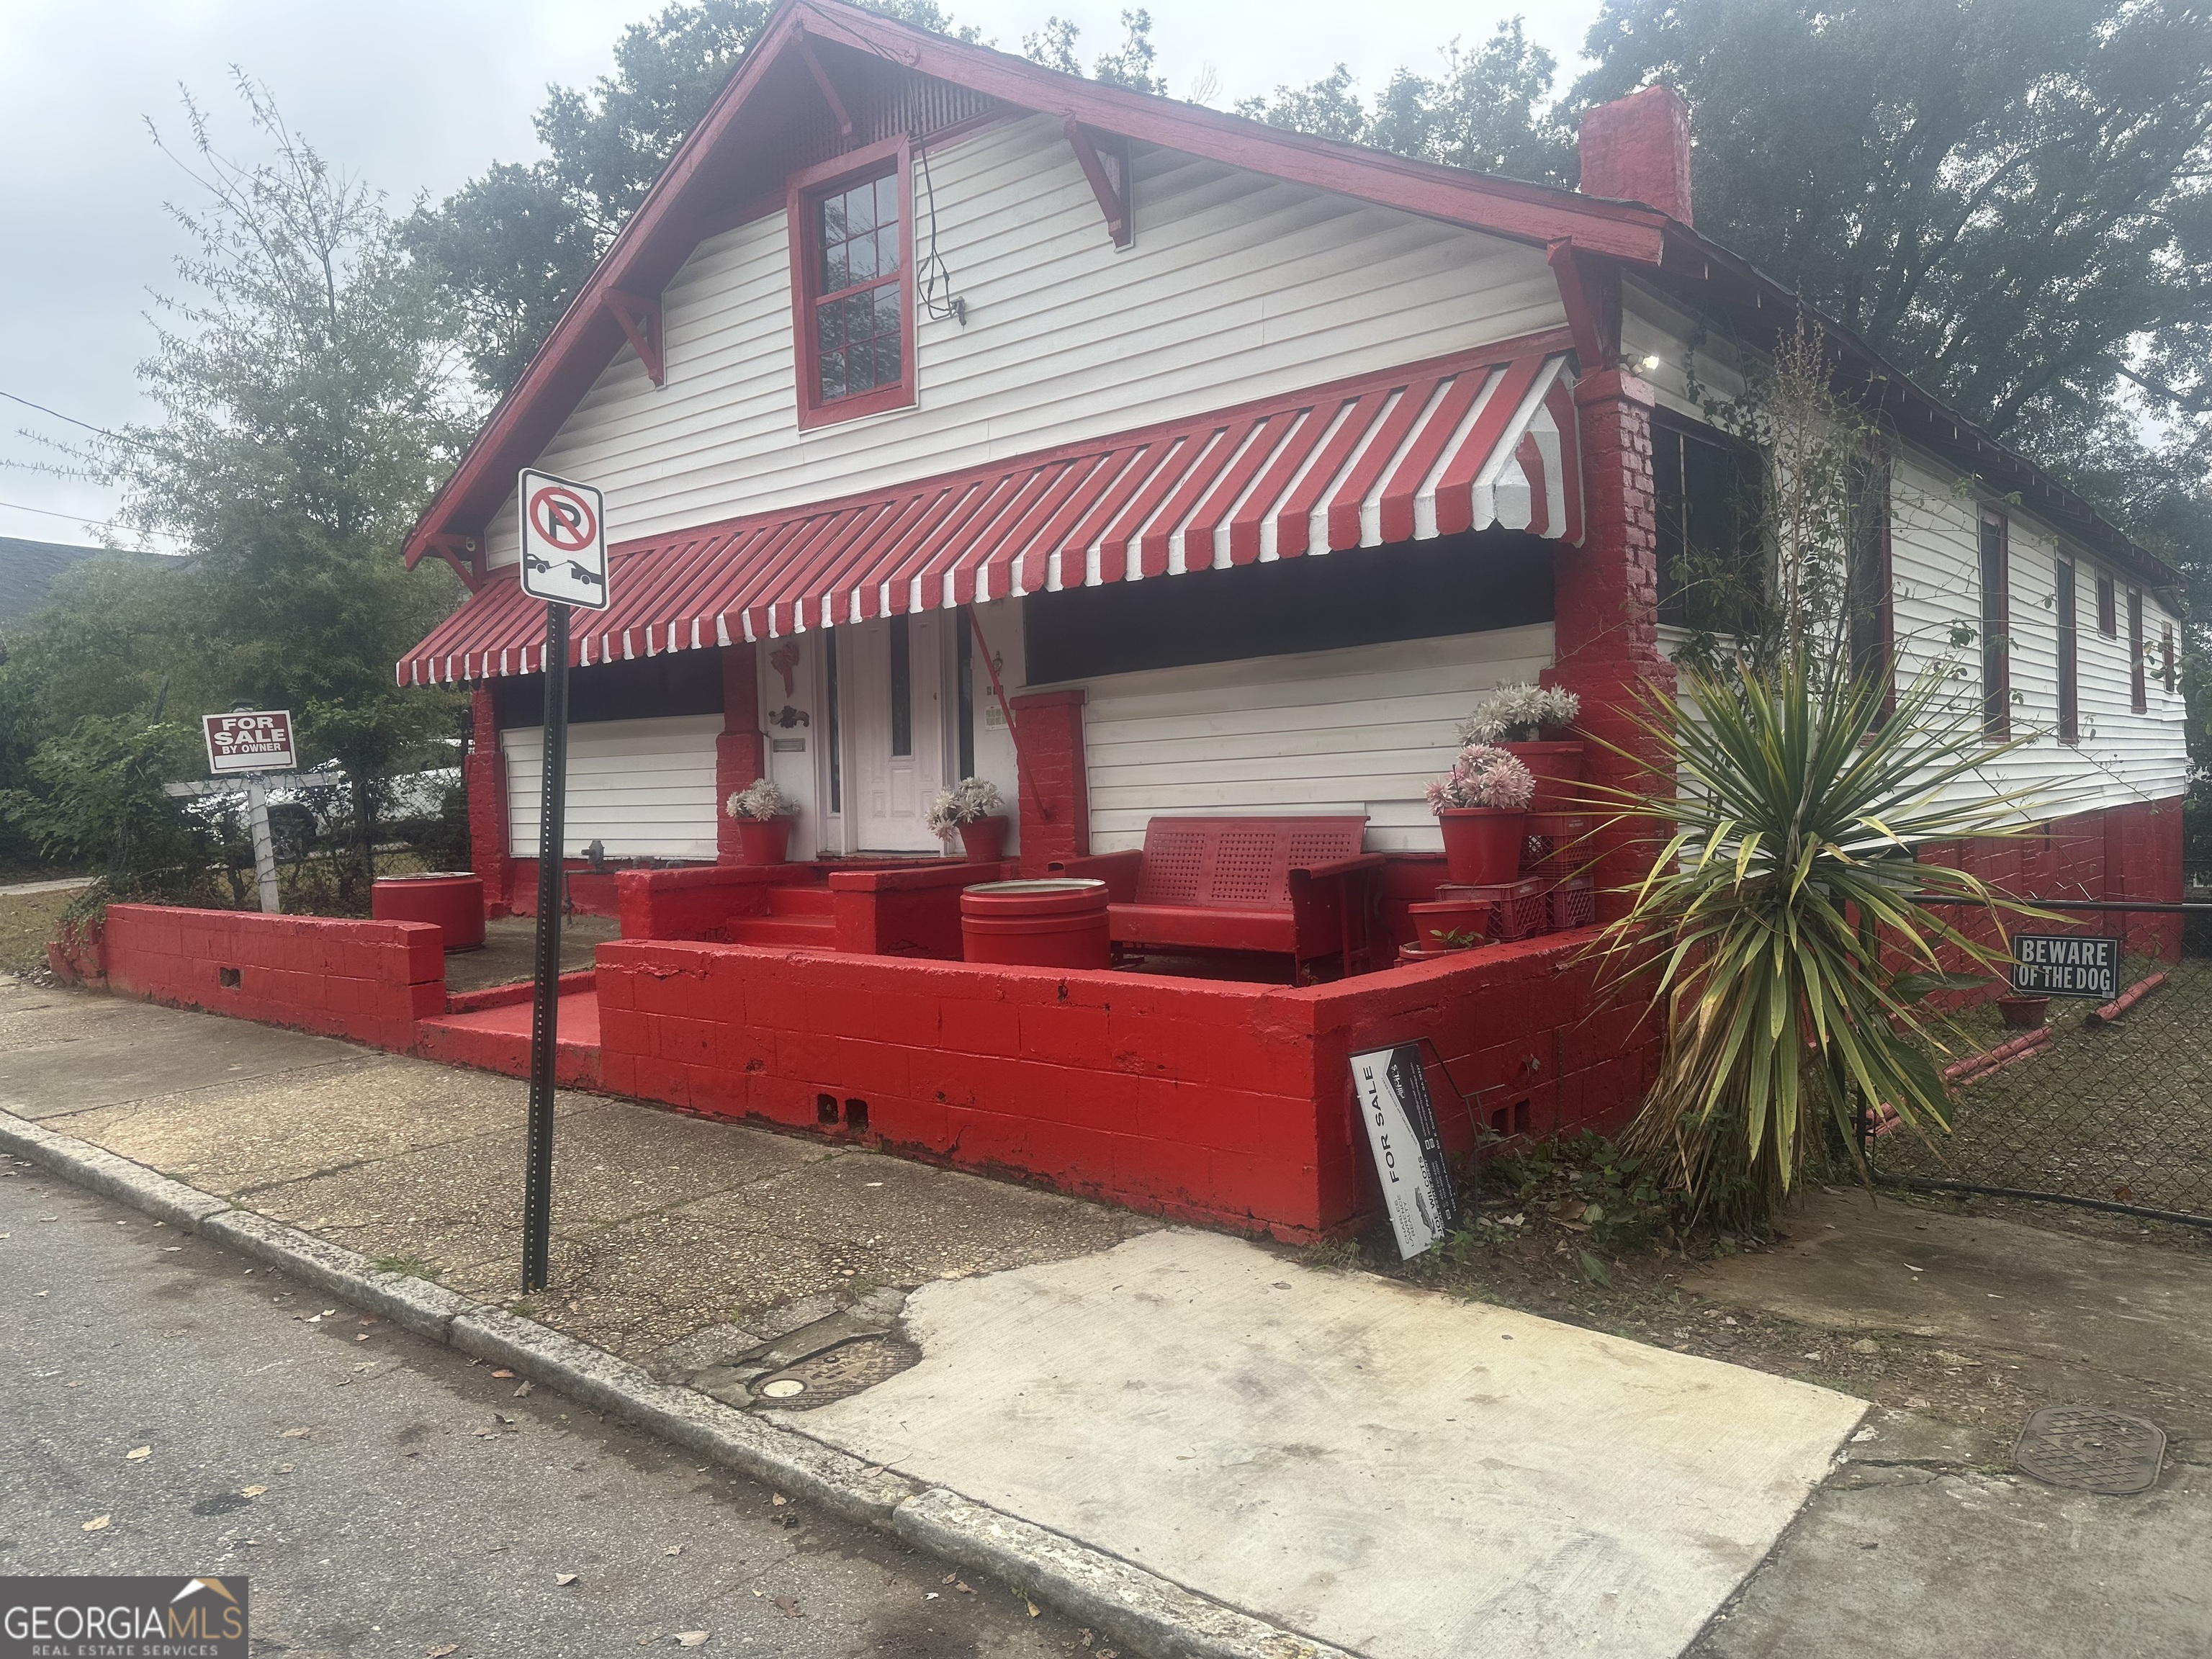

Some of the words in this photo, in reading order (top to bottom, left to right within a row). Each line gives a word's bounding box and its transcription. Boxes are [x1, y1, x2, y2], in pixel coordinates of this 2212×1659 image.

[222, 716, 274, 731] FOR
[214, 729, 286, 745] SALE
[222, 745, 238, 754] BY
[241, 742, 282, 753] OWNER
[2022, 940, 2108, 966] BEWARE
[2018, 965, 2038, 986] OF
[2042, 966, 2072, 989] THE
[2076, 967, 2110, 991] DOG
[1363, 1066, 1384, 1127] SALE
[1380, 1133, 1400, 1183] FOR
[1418, 1156, 1435, 1210] WILCOTS
[1396, 1194, 1414, 1247] LAWRENCE
[1402, 1201, 1416, 1237] REALTY
[1432, 1211, 1443, 1235] JOE
